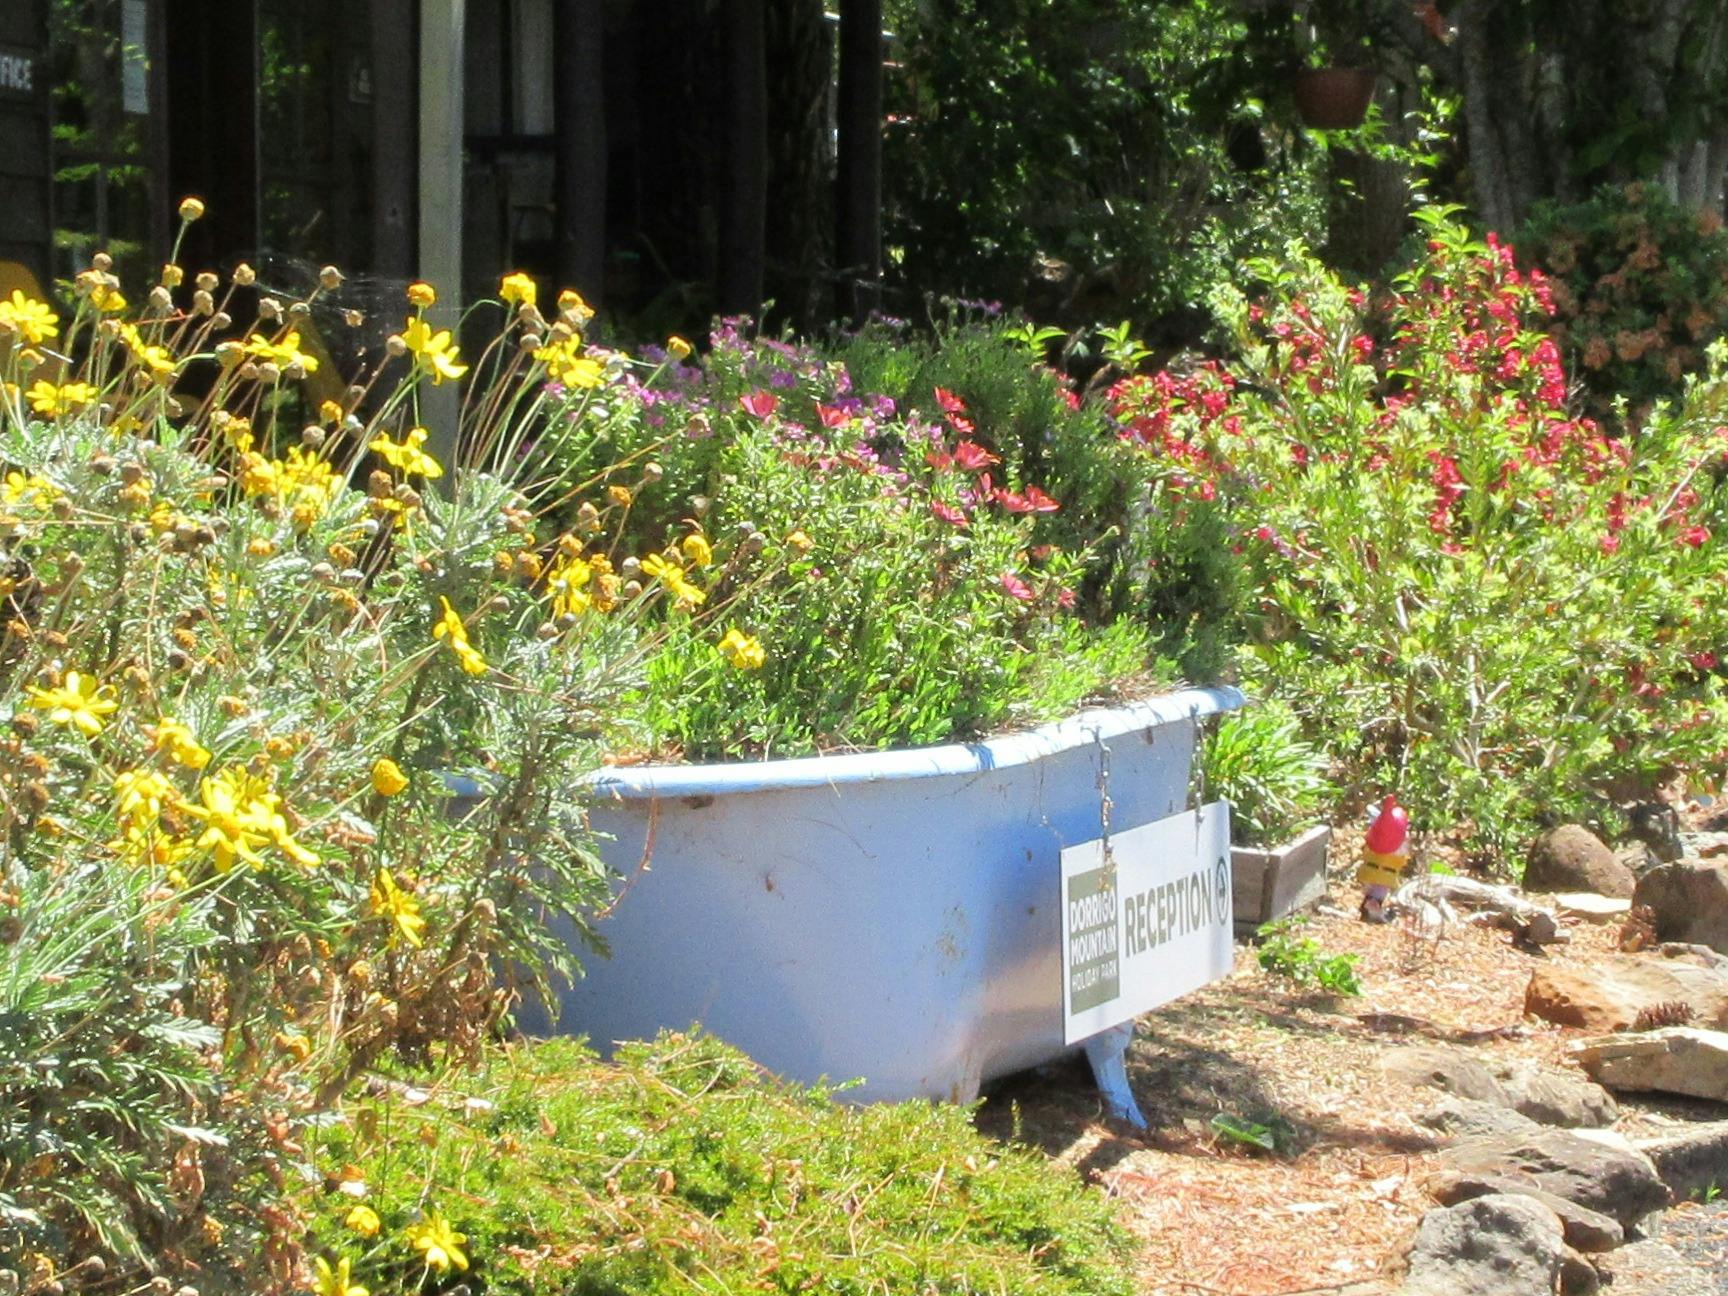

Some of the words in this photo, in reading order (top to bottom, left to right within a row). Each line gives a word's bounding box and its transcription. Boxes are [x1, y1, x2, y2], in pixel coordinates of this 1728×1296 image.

[1070, 887, 1116, 934] DORRIGO
[1124, 867, 1213, 958] RECEPTION
[1070, 924, 1117, 967] MOUNTAIN
[1071, 965, 1101, 993] HOLIDAY
[1101, 959, 1117, 978] PARK
